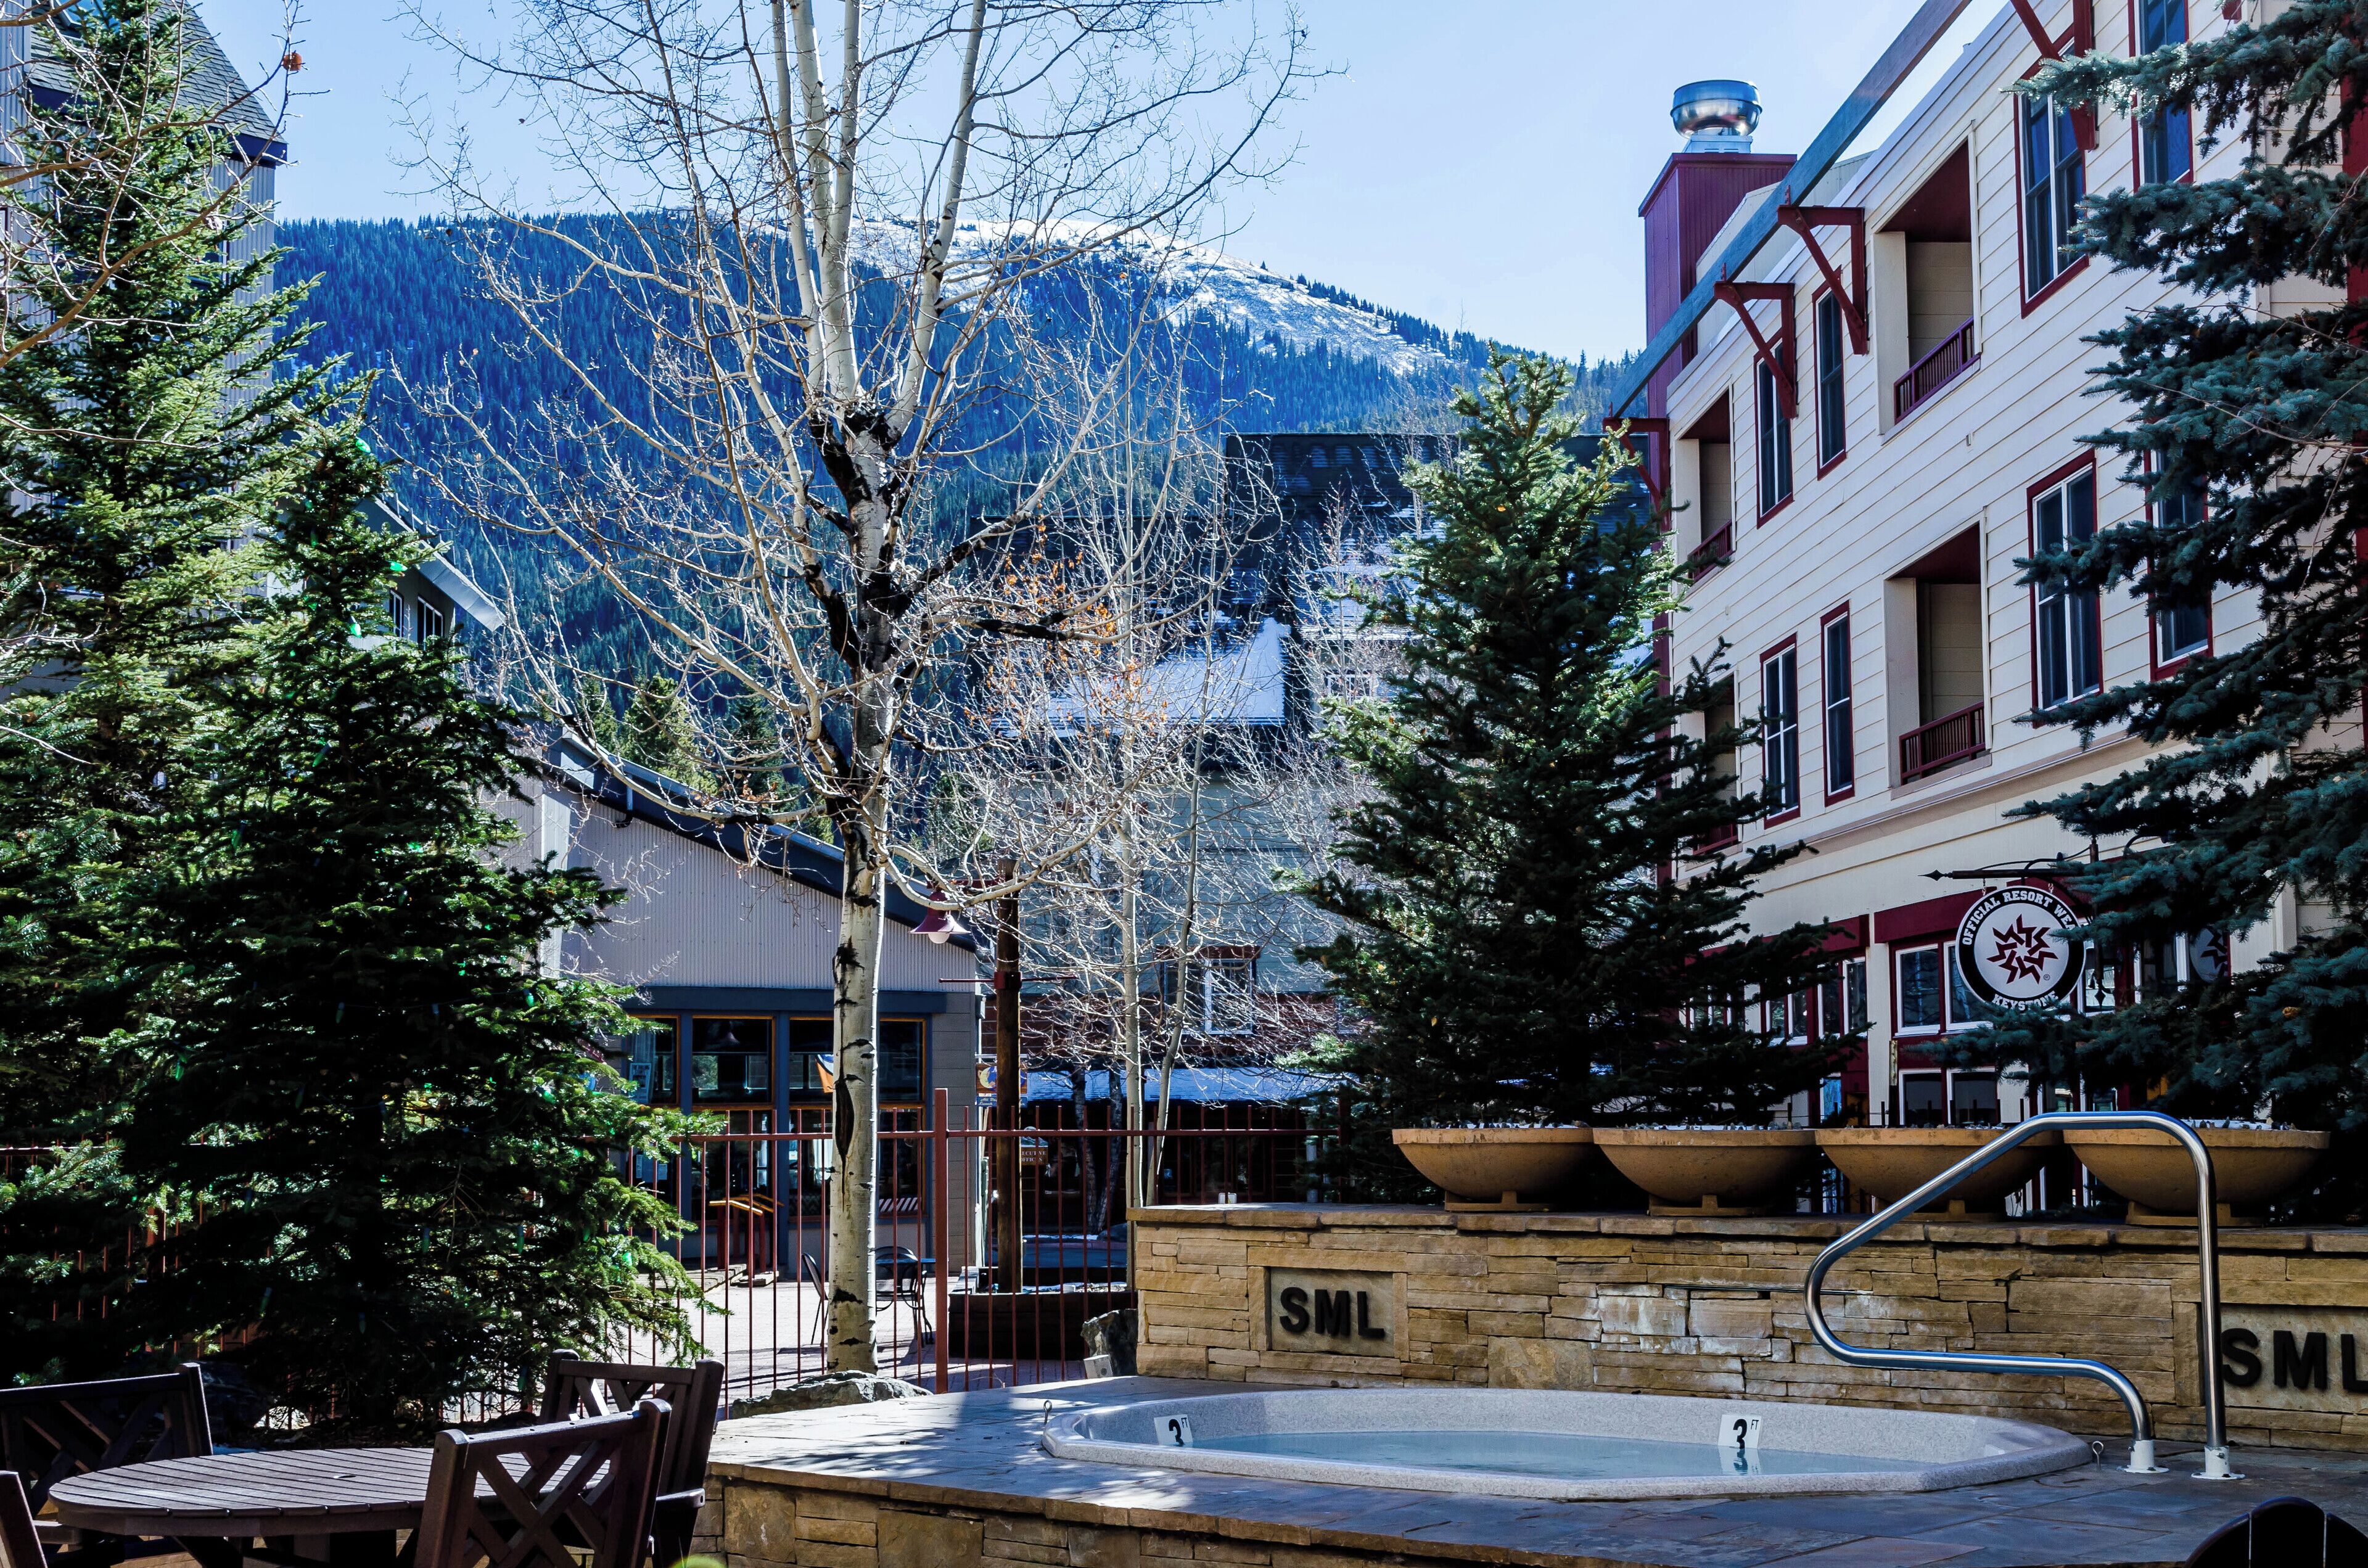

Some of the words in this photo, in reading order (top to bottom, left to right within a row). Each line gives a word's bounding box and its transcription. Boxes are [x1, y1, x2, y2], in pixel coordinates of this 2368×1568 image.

[1962, 897, 2000, 945] OFFICIAL
[2002, 890, 2053, 908] RESORT
[2054, 904, 2076, 931] WEA
[1992, 990, 2058, 1011] KEYSTONE
[1280, 1286, 1384, 1339] SML
[2221, 1328, 2368, 1393] SML
[1751, 1419, 1759, 1430] FT
